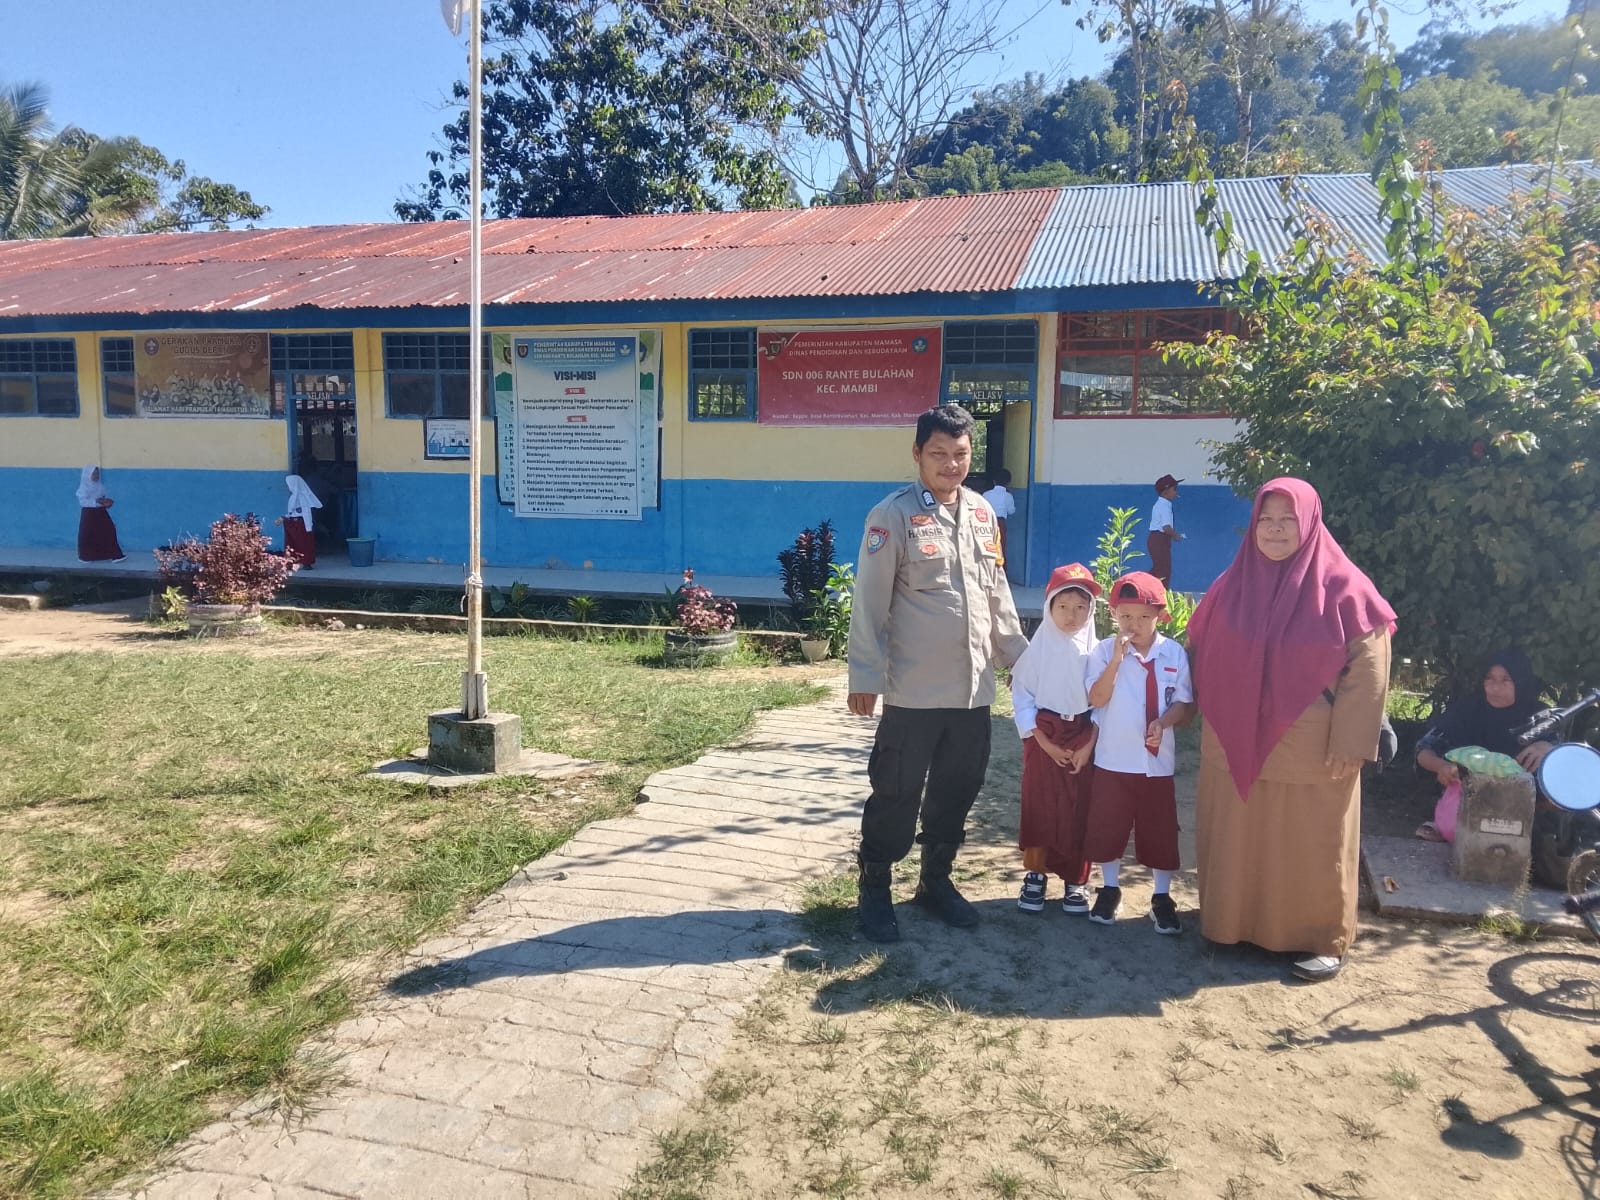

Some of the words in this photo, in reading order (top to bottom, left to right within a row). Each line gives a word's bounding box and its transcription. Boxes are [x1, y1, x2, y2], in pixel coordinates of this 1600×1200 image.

[554, 371, 596, 381] VISI-MISI
[782, 371, 803, 380] SDN
[805, 370, 823, 380] 006
[825, 370, 859, 379] RANTE
[862, 368, 914, 378] BULAHAN
[816, 384, 838, 394] KEC.
[841, 383, 878, 393] MAMBI
[973, 391, 996, 400] KELAS
[997, 391, 1003, 399] V
[908, 527, 944, 539] HAMSIR
